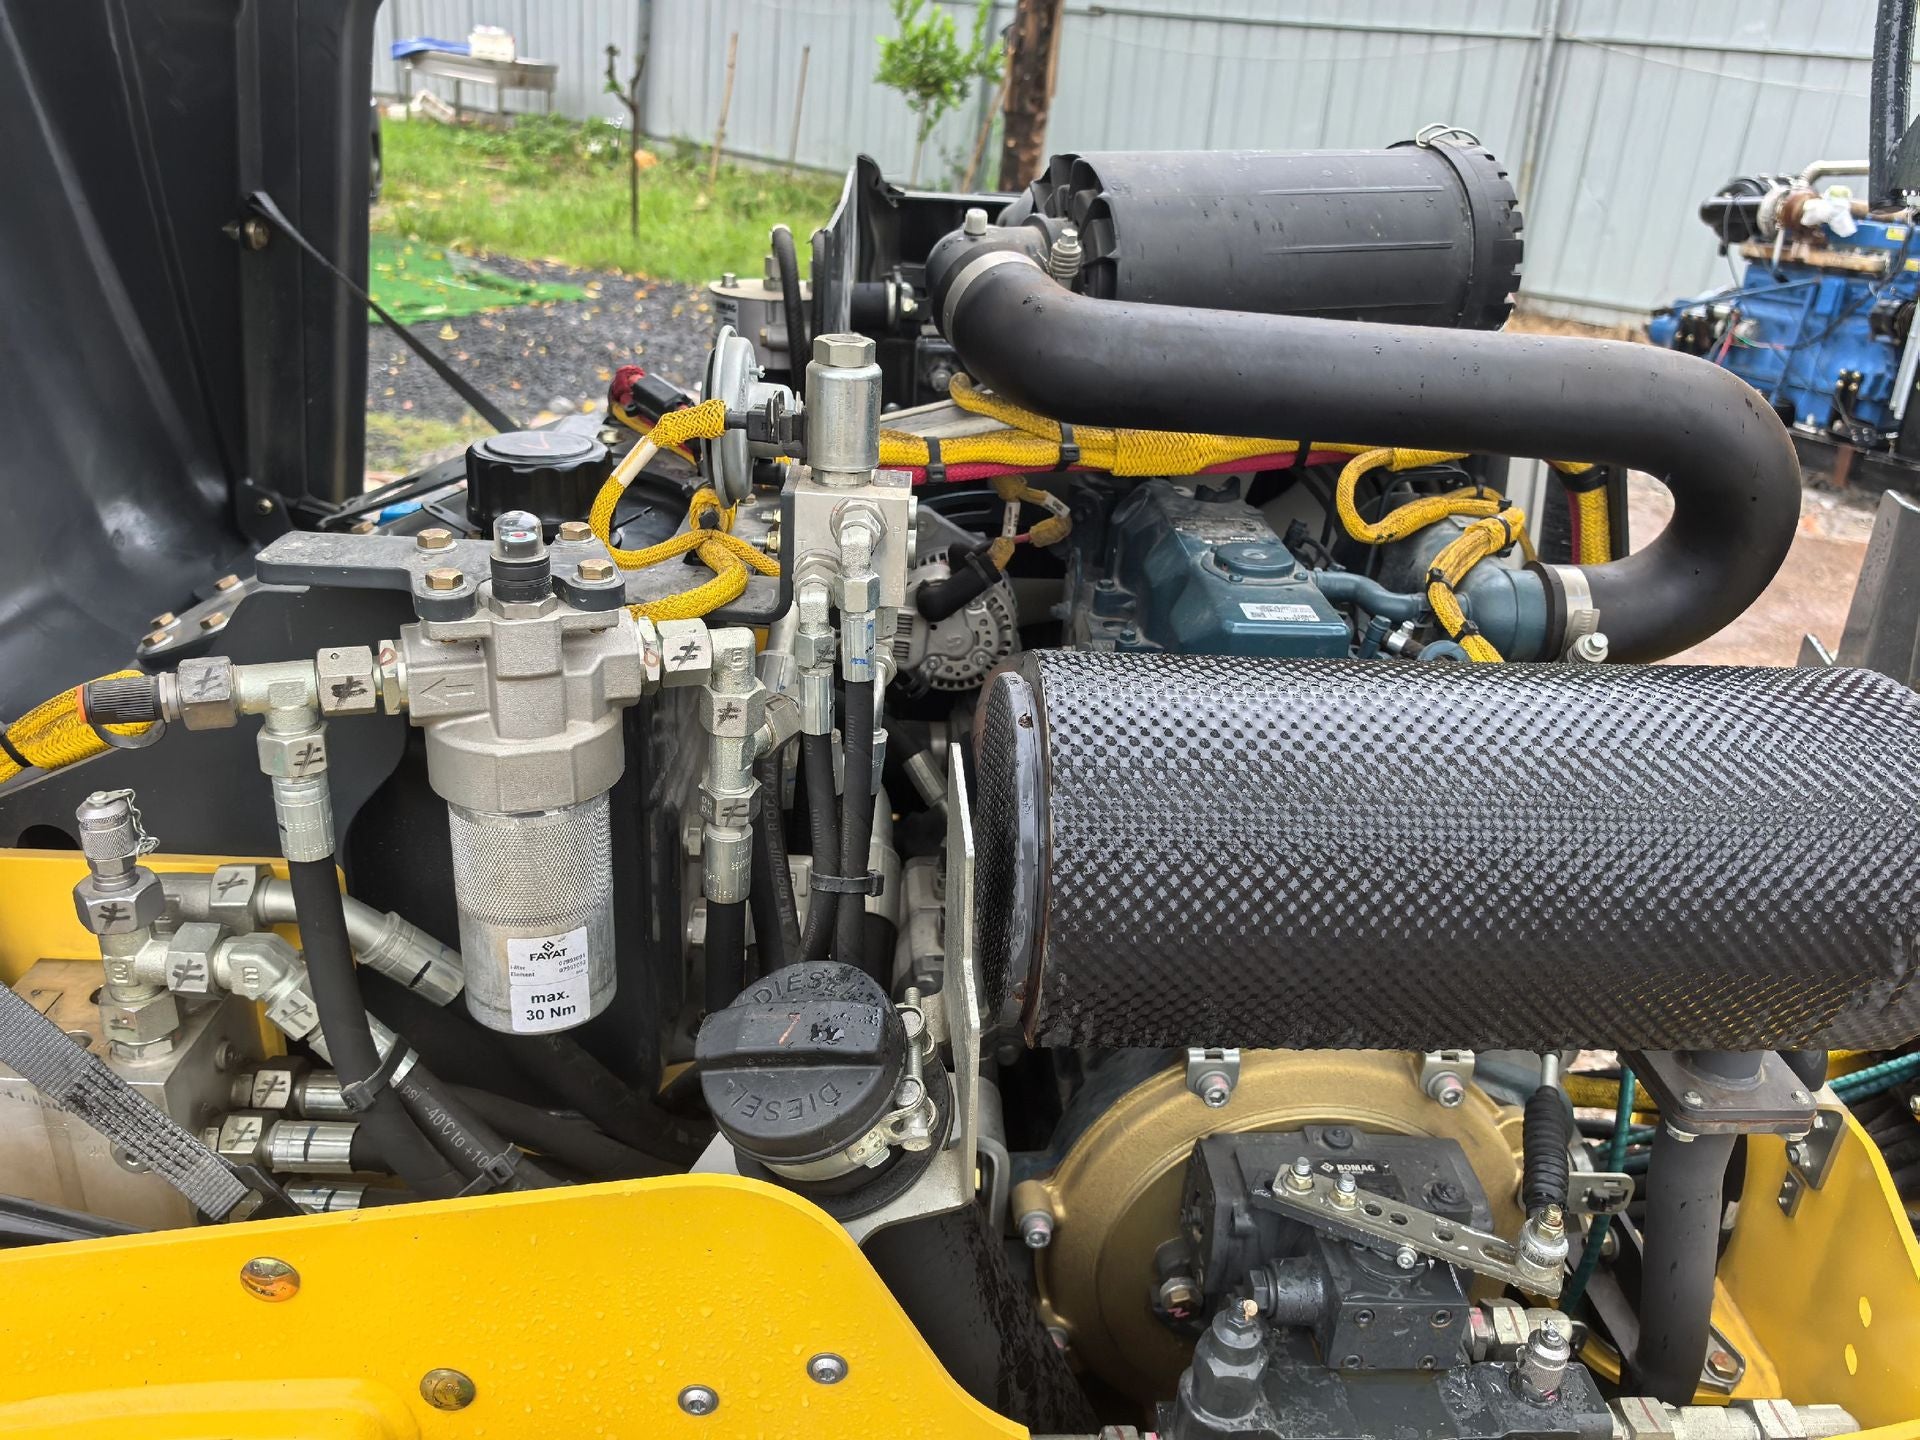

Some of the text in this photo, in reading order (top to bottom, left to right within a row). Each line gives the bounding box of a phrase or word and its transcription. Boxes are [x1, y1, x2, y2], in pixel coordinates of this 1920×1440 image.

[529, 948, 568, 962] FAYAT
[531, 990, 570, 1004] max.
[526, 1004, 577, 1021] 30 Nm
[731, 1081, 842, 1122] DIESEL
[464, 1146, 490, 1169] +10
[1336, 1163, 1376, 1173] BOMAG
